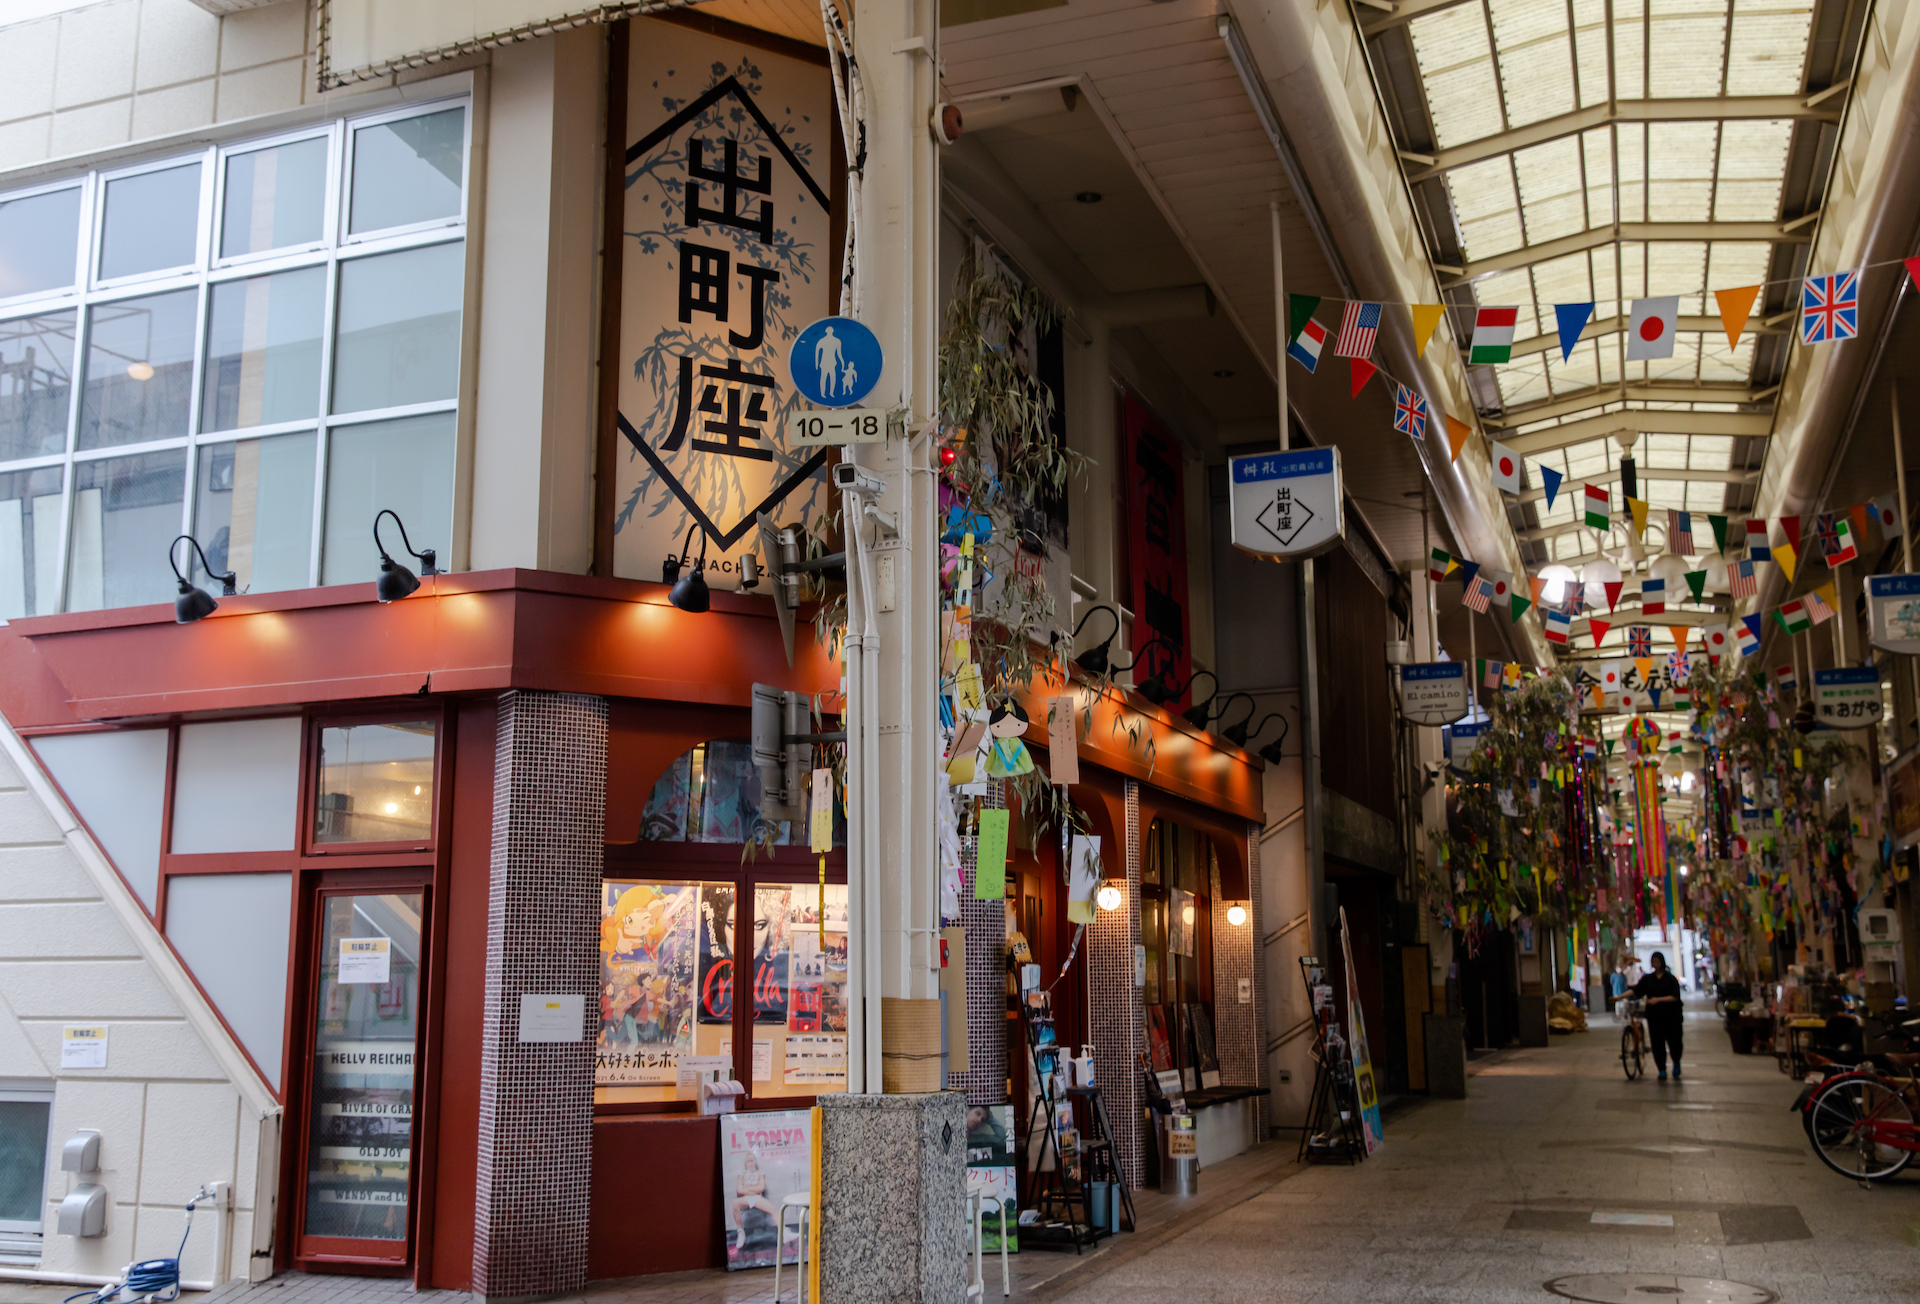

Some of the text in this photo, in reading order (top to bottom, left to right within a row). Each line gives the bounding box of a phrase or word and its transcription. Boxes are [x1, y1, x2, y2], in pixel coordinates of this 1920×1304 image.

[660, 138, 780, 463] 出町座
[1277, 487, 1292, 531] 出町座
[1407, 690, 1460, 700] El camino
[331, 1053, 415, 1065] KELLY REICHA
[341, 1103, 373, 1114] RIVER
[376, 1104, 388, 1114] OF
[745, 1128, 806, 1148] TONYA
[359, 1149, 402, 1158] OLD JOY
[335, 1190, 372, 1200] WENDY
